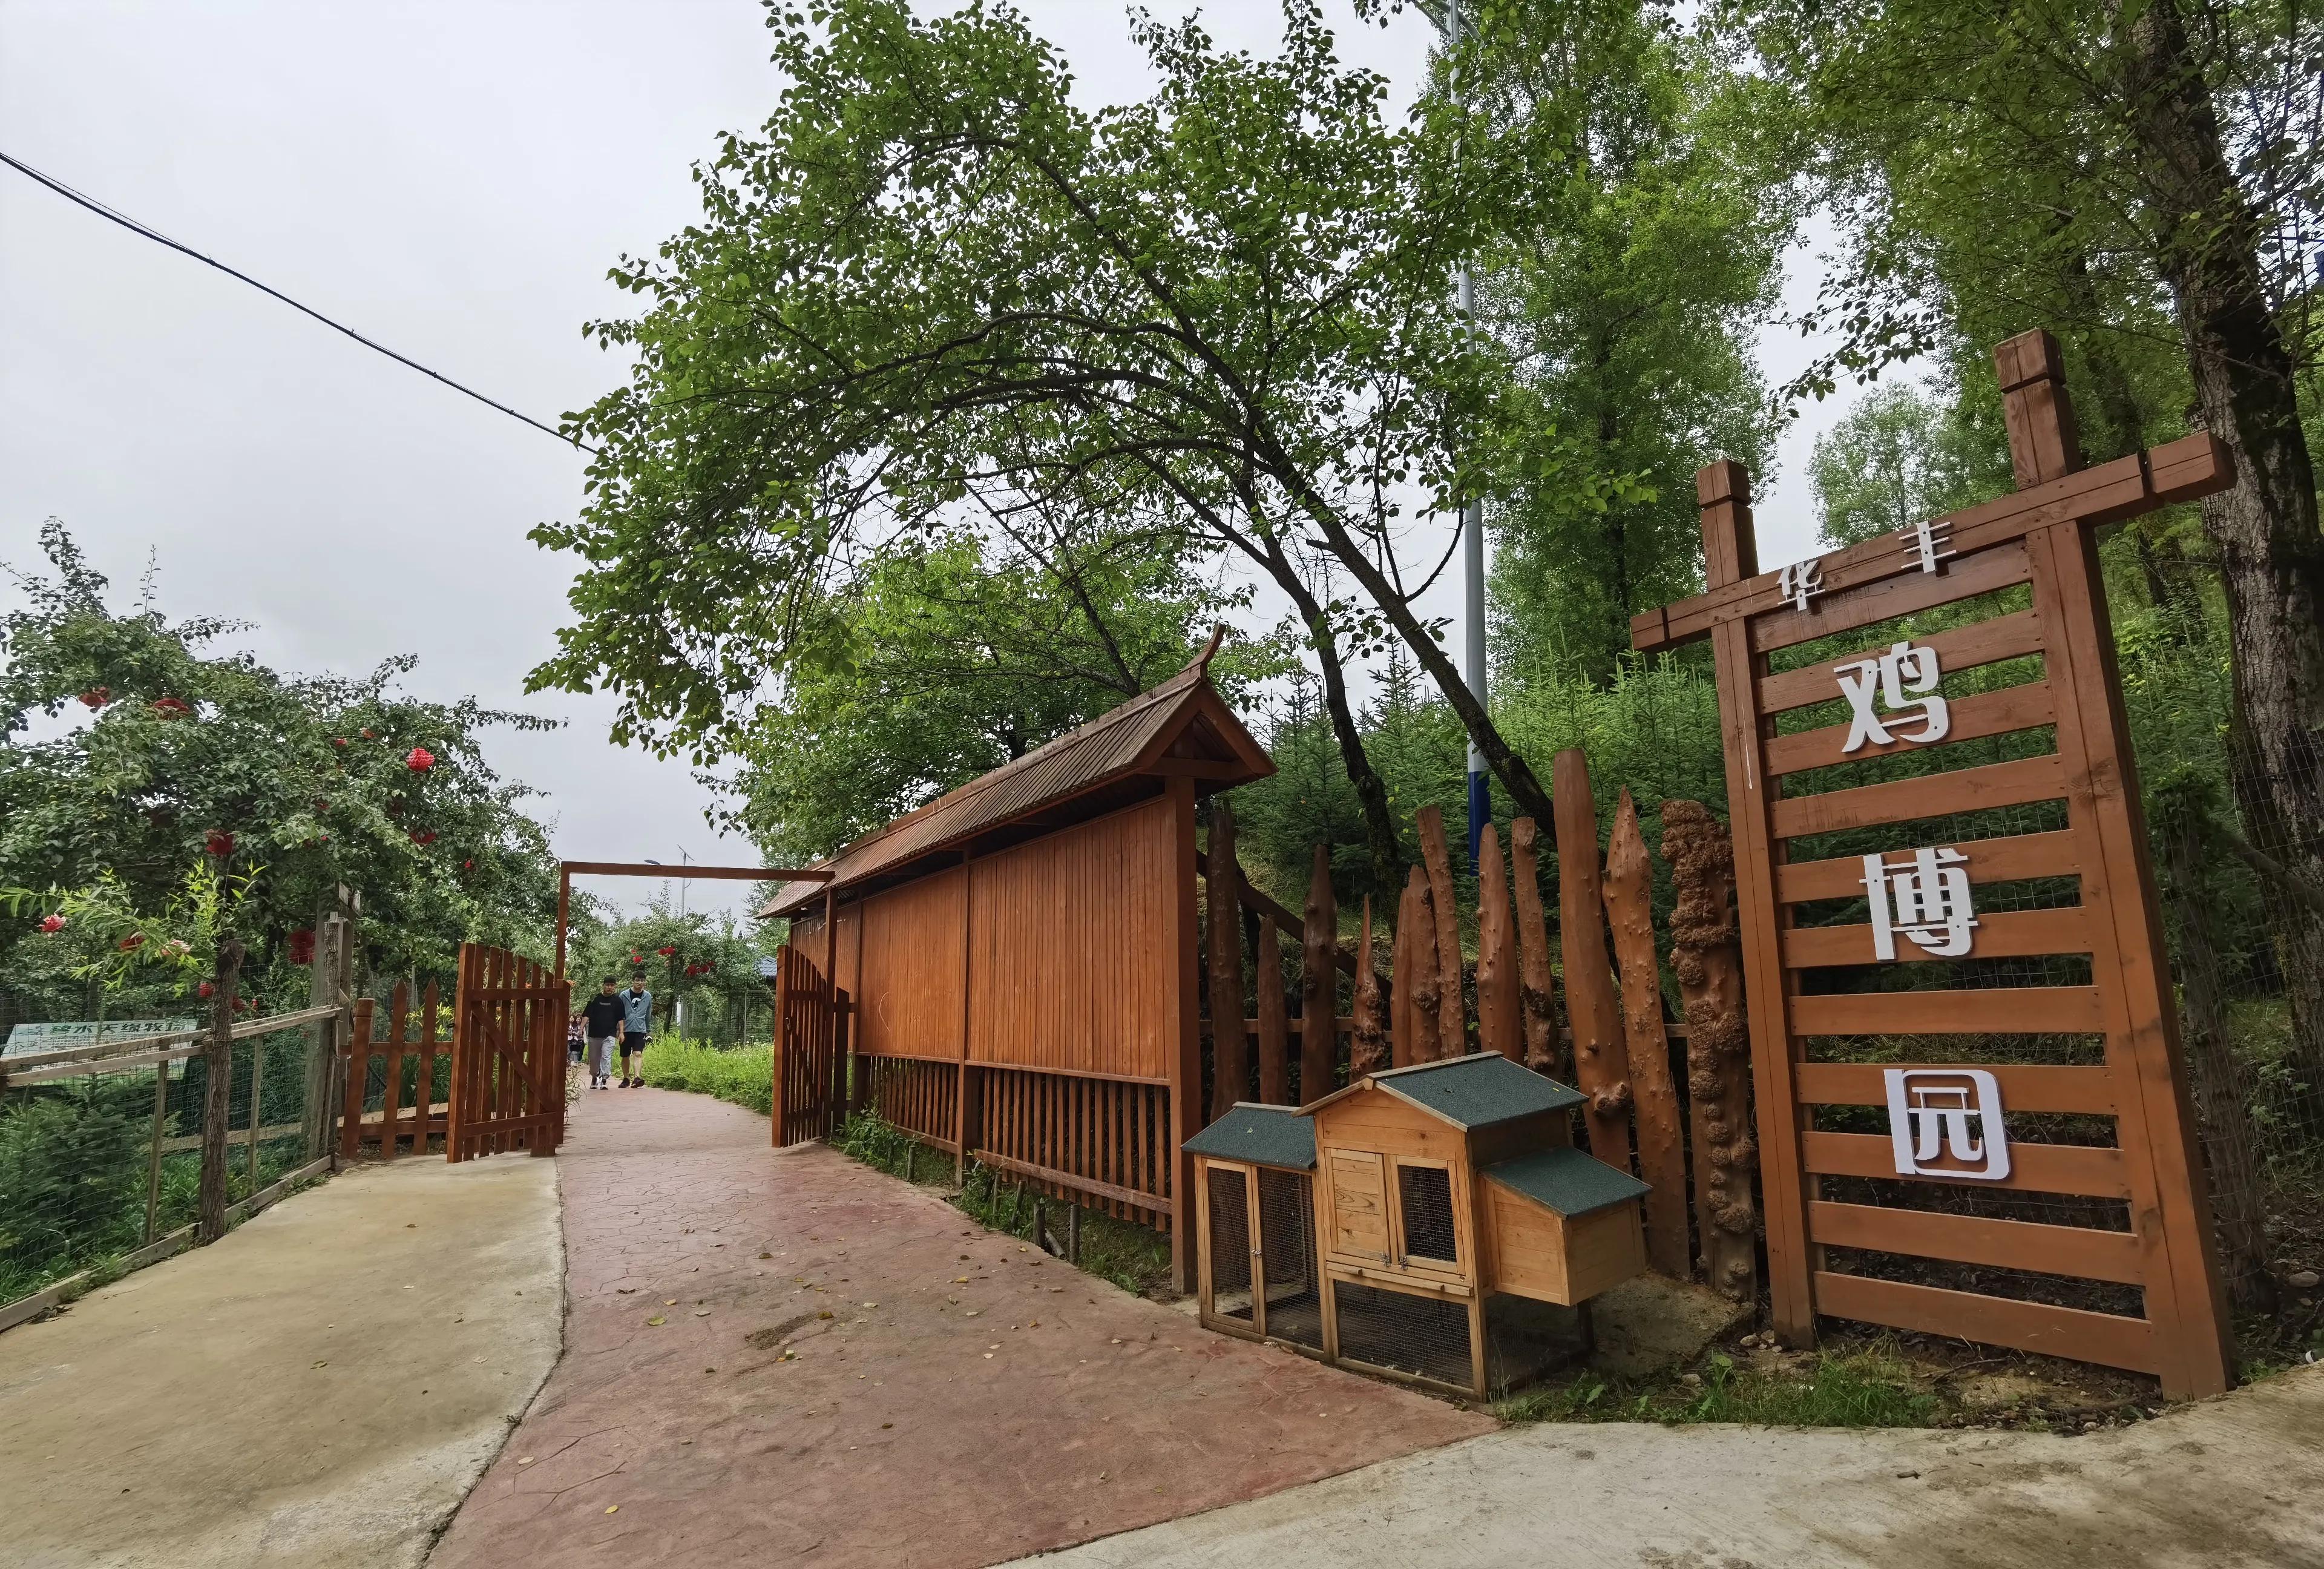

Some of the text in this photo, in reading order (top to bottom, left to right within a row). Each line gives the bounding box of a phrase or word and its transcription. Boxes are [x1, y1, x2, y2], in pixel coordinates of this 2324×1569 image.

[1777, 521, 1957, 611] 华丰
[1834, 641, 2011, 1180] 鸡博园
